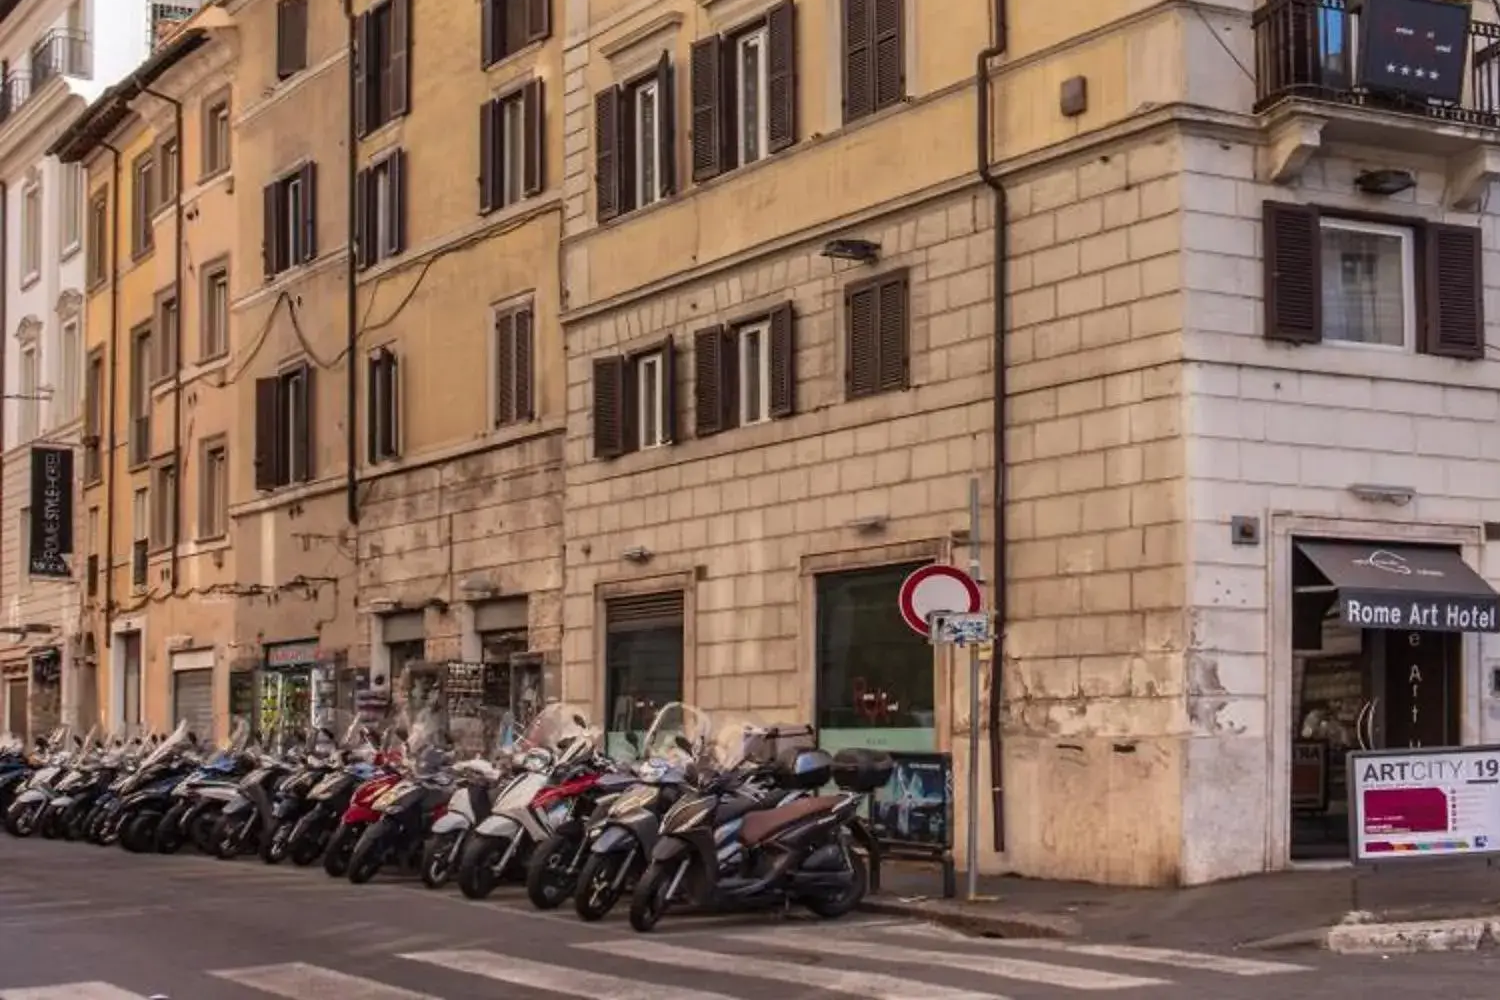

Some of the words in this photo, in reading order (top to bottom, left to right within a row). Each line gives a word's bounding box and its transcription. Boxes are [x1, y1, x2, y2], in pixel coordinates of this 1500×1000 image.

[1347, 599, 1401, 624] Rome
[1408, 602, 1439, 626] Art
[1446, 604, 1496, 628] Hotel
[1363, 759, 1463, 782] ARTCITY
[1474, 759, 1499, 777] 19
